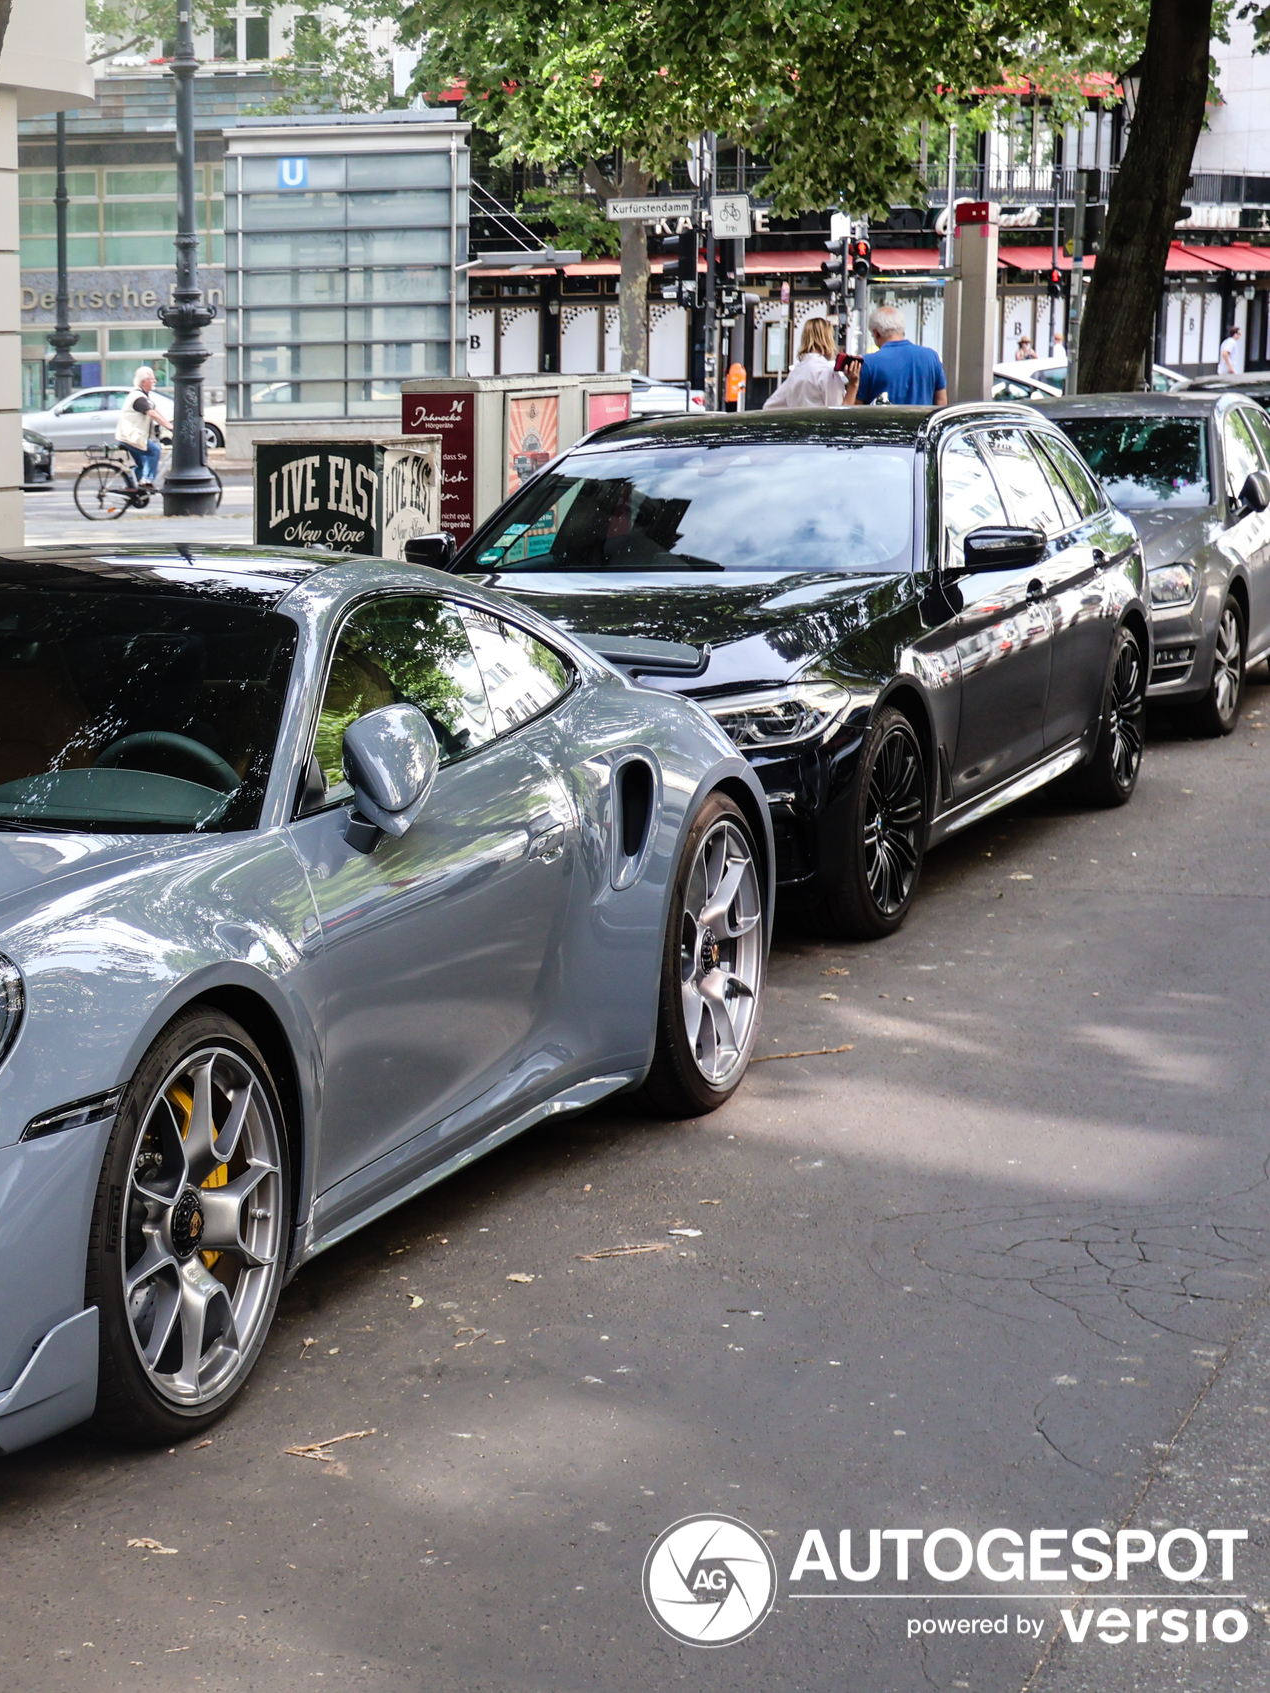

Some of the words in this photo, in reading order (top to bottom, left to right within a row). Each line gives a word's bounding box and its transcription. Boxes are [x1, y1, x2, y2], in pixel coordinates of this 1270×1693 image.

[282, 159, 303, 186] U
[612, 202, 689, 214] Kurfürstendamm
[725, 223, 738, 233] frei
[20, 284, 157, 310] Detsche
[470, 335, 481, 349] B
[411, 406, 462, 427] Jahnecke
[443, 453, 456, 461] dass
[457, 453, 468, 461] Sie
[269, 455, 320, 529] LIVE
[327, 455, 379, 531] FAST
[385, 456, 410, 529] LIVE
[284, 520, 323, 541] New
[325, 521, 365, 542] Store
